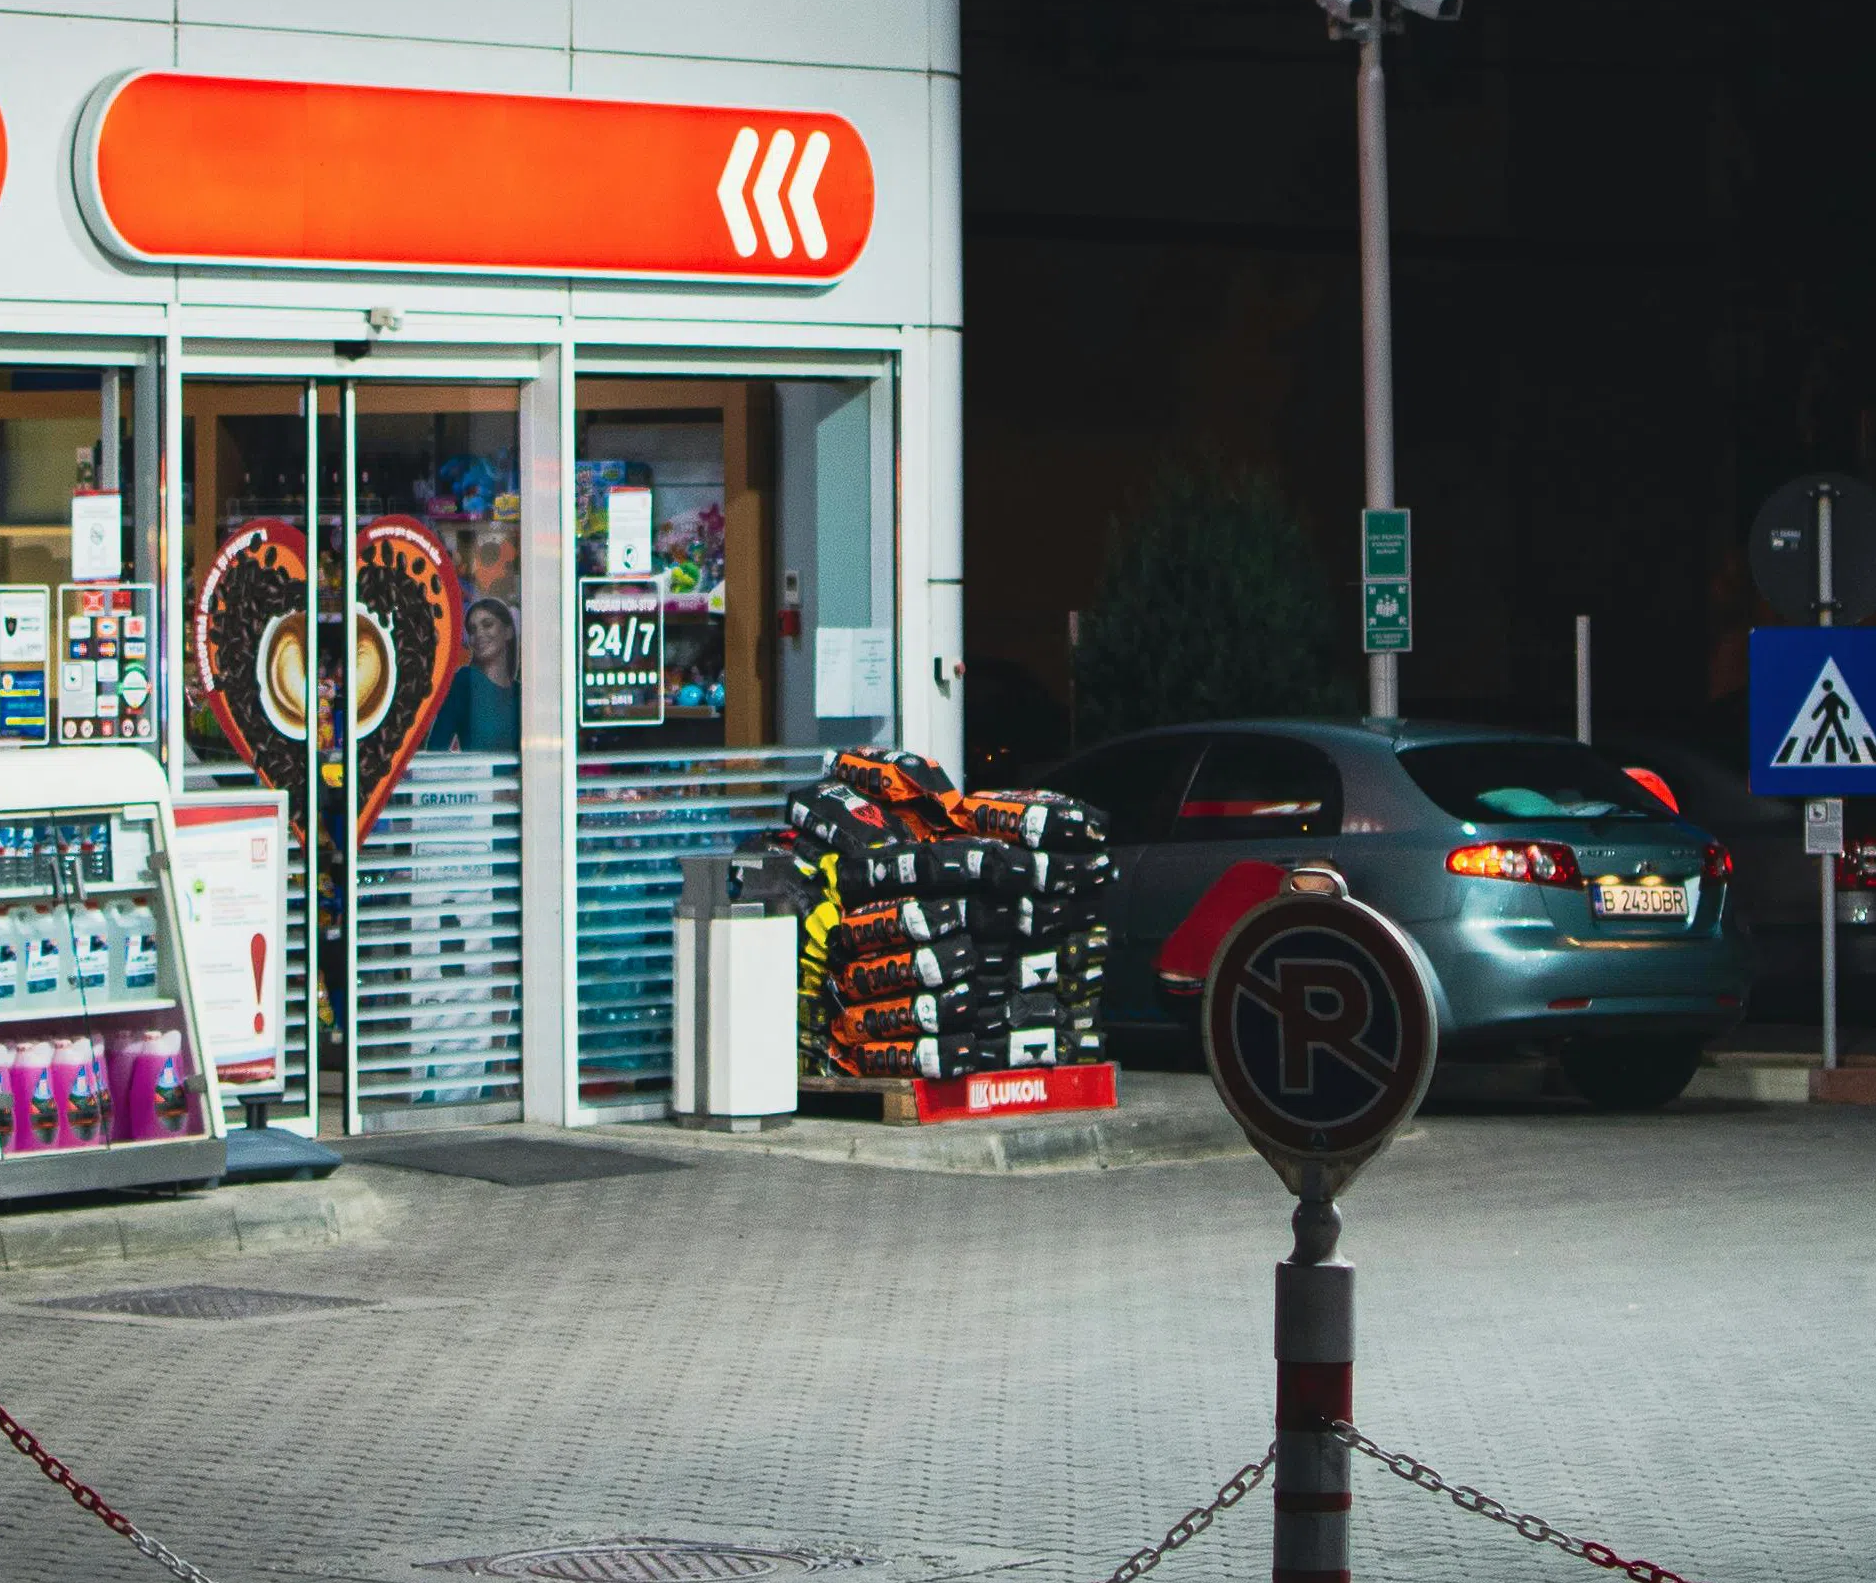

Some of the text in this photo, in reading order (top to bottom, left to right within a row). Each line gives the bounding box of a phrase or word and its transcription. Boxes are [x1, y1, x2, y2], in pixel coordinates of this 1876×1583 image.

[588, 616, 655, 663] 24/7
[1603, 890, 1616, 912] B
[990, 1079, 1048, 1106] LUKOIL
